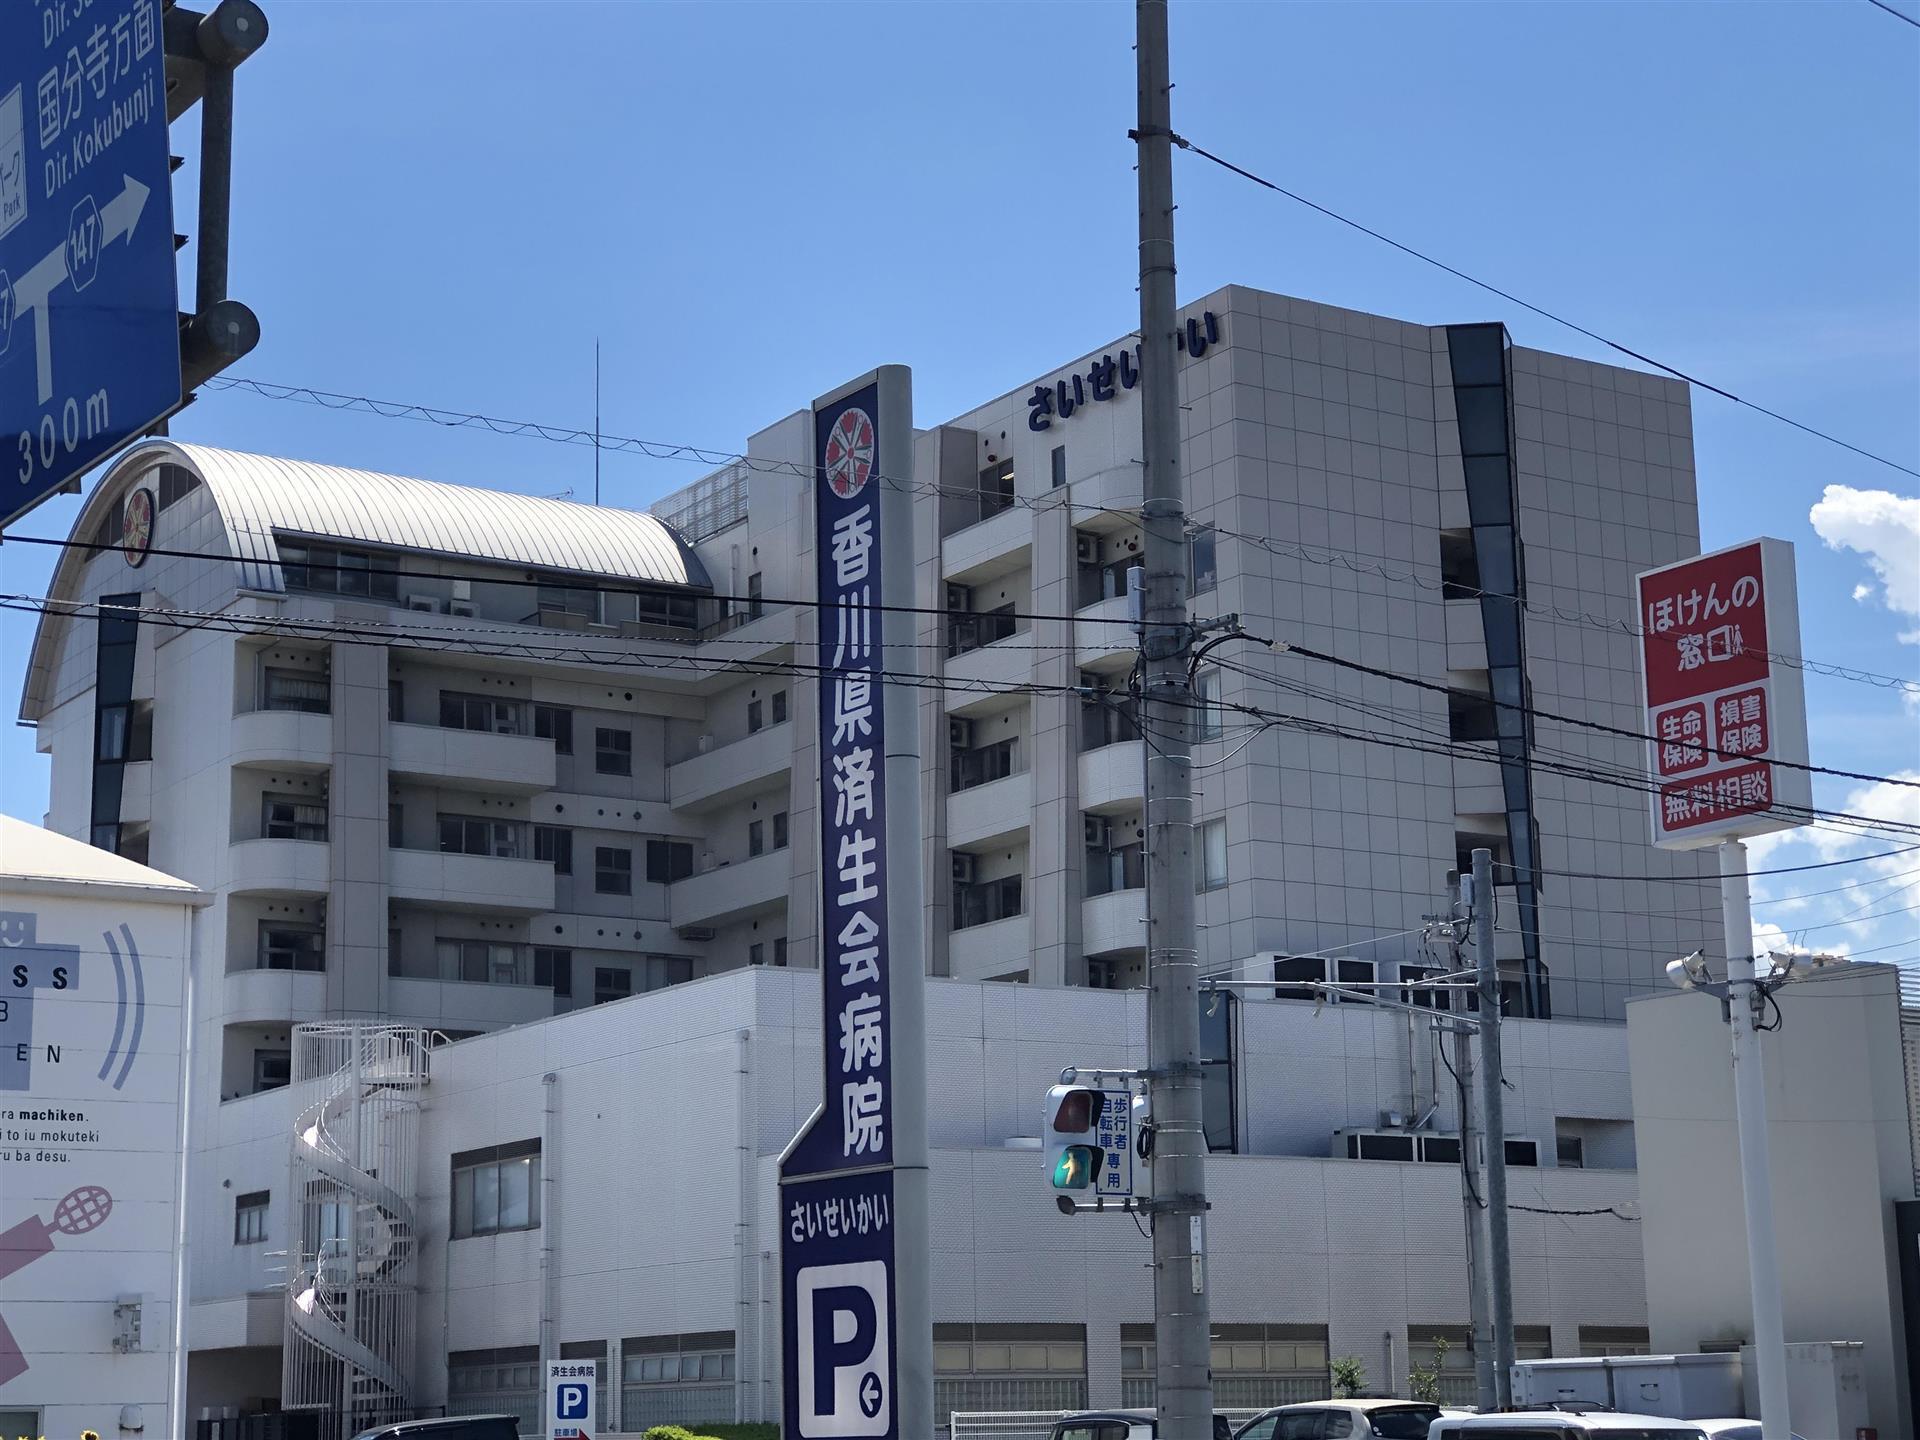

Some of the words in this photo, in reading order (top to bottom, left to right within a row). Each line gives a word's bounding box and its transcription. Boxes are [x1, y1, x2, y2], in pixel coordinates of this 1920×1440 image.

[38, 0, 155, 151] 国分寺方面
[4, 193, 21, 222] Park
[71, 214, 95, 271] 147
[1028, 311, 1219, 432] さいせいい
[19, 388, 109, 485] 300m
[1648, 575, 1760, 635] ほけんの
[1677, 624, 1734, 672] 窓口
[1662, 710, 1702, 741] 生命
[1720, 694, 1762, 726] 損害
[1662, 738, 1703, 770] 保険
[1720, 724, 1763, 755] 保険
[1665, 770, 1769, 824] 無料相談
[831, 503, 884, 1158] 香川県済生会病院
[7, 1129, 20, 1141] to
[24, 1128, 36, 1141] iu
[40, 1130, 99, 1142] mokuteki
[19, 1108, 89, 1122] machiken.
[1099, 1098, 1114, 1149] 自転車
[1113, 1098, 1128, 1150] 歩行者
[15, 1149, 31, 1162] ba
[35, 1150, 71, 1162] desu.
[1107, 1152, 1121, 1189] 専用
[790, 1194, 889, 1242] さいせいかい
[551, 1366, 595, 1377] 済生会病院
